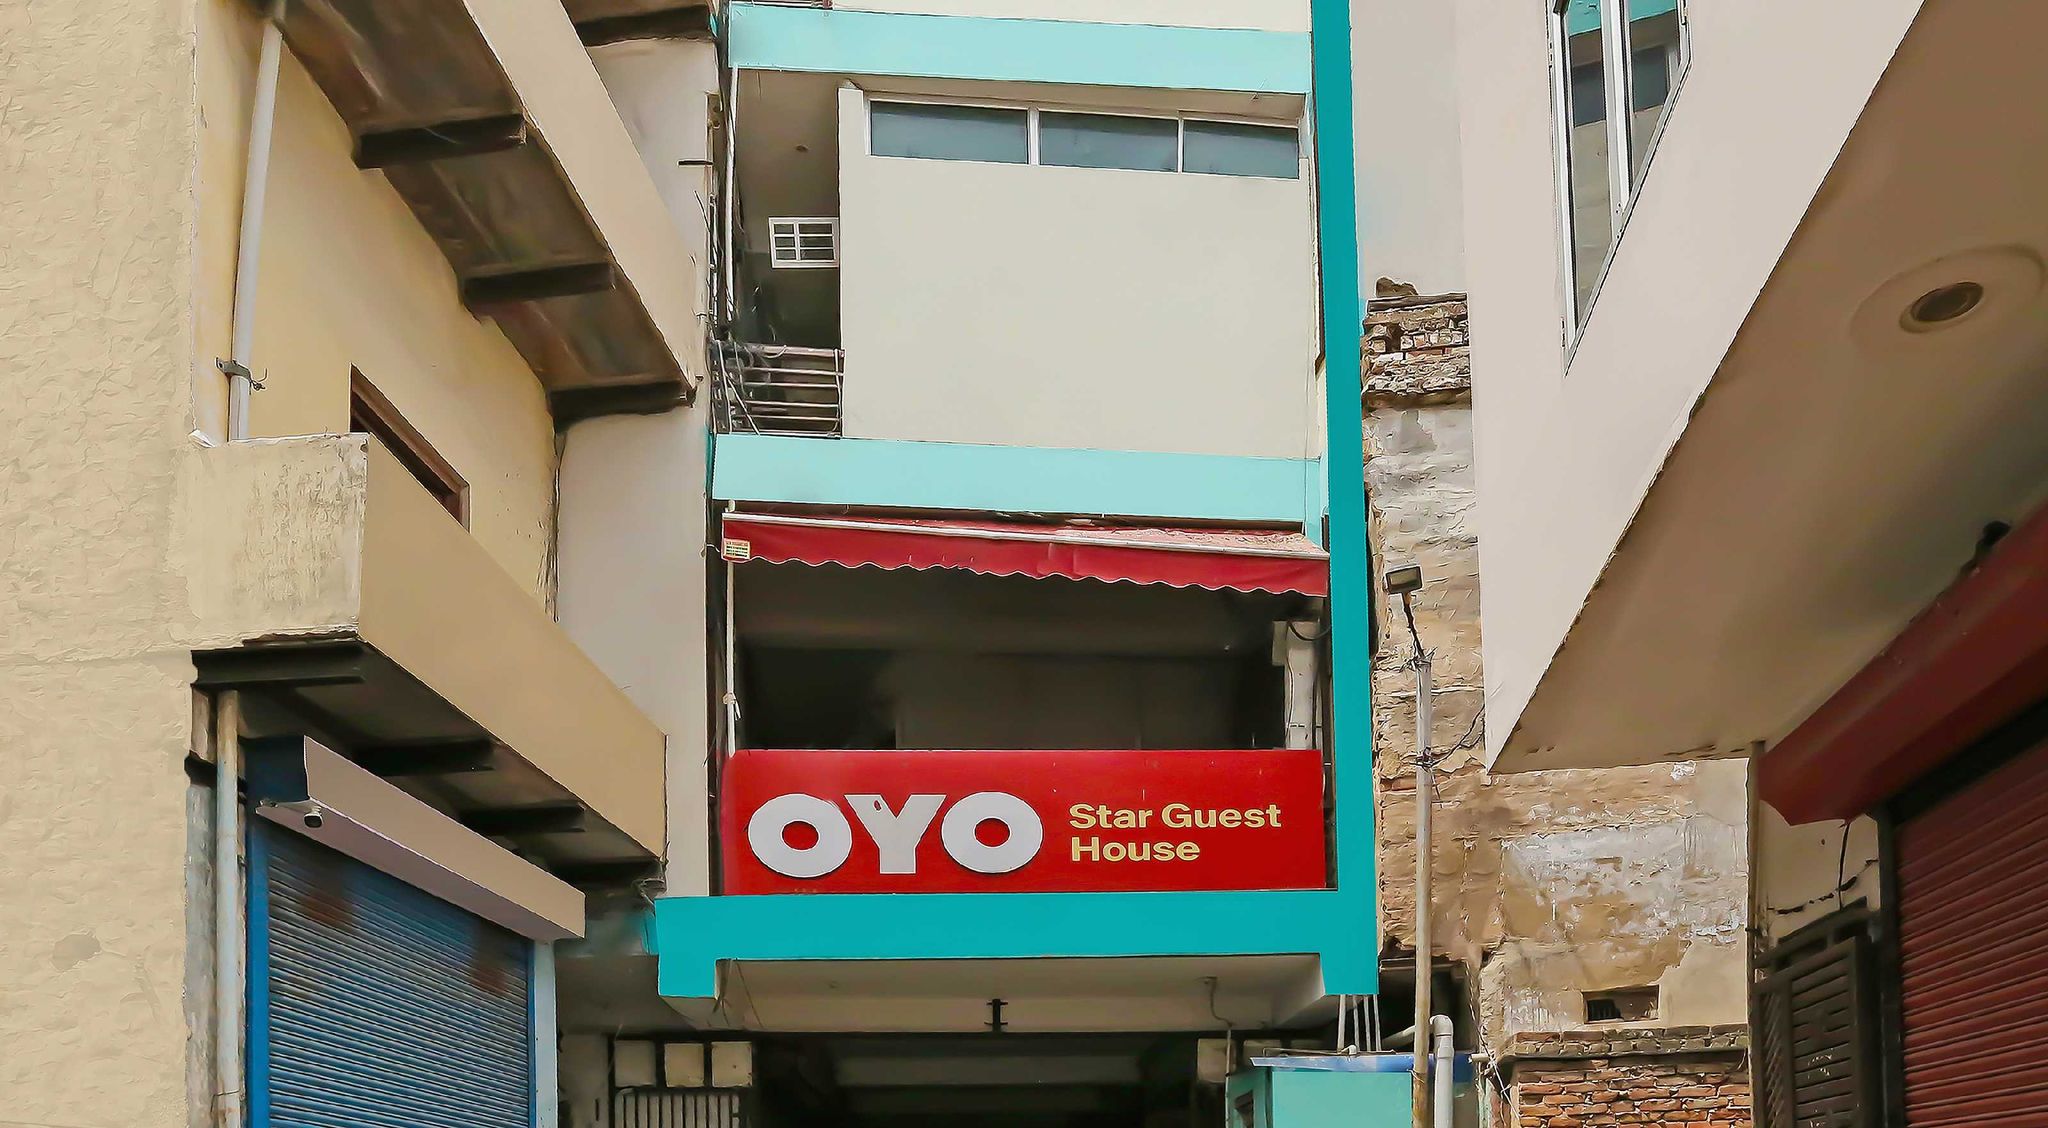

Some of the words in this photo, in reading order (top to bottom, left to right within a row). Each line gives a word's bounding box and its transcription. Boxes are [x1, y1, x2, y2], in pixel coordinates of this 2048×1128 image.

[1069, 803, 1153, 829] Star
[1161, 803, 1282, 829] Guest
[747, 791, 1044, 878] OYO
[1071, 836, 1201, 862] House
